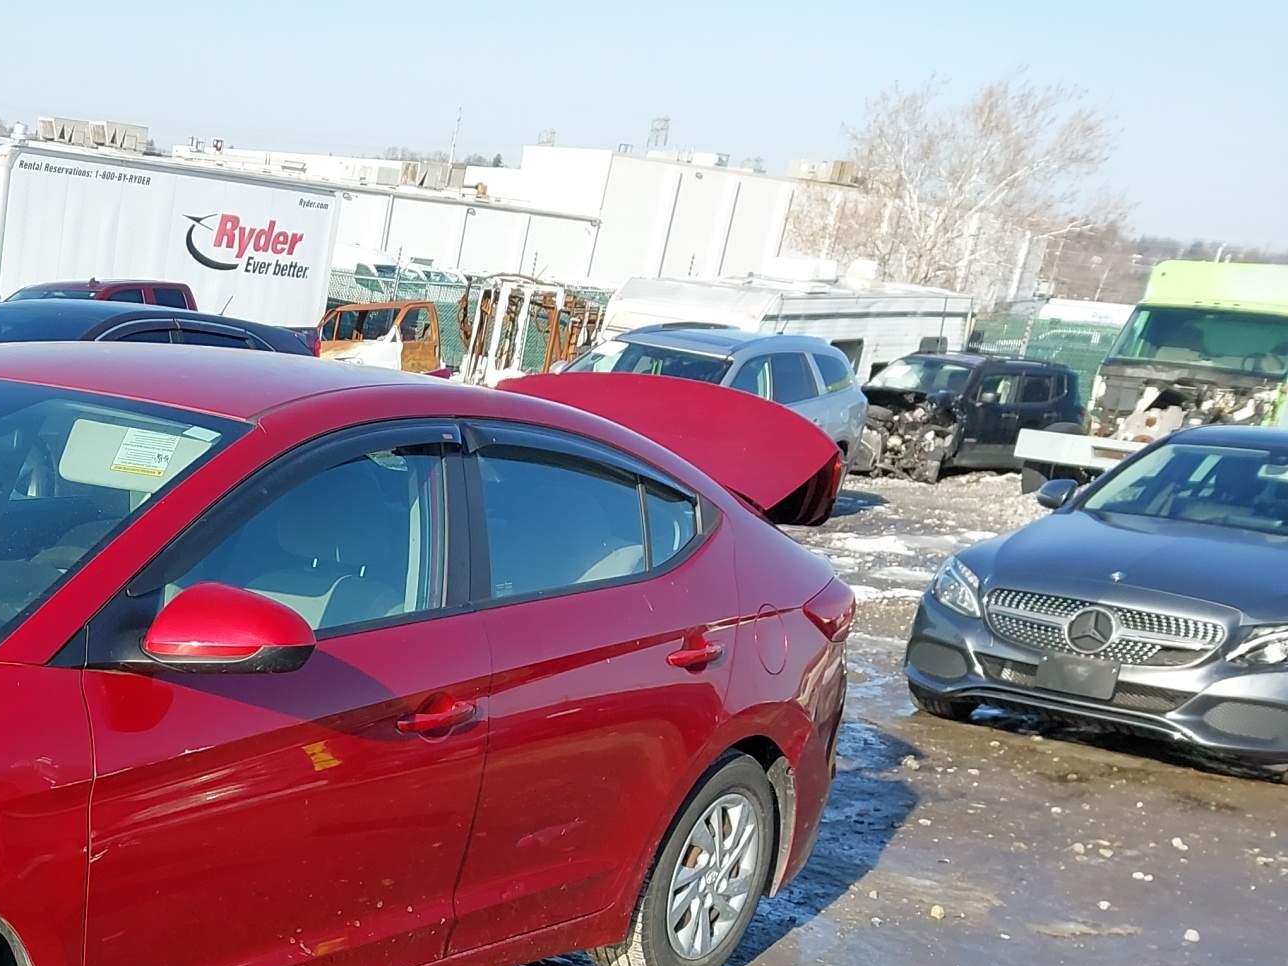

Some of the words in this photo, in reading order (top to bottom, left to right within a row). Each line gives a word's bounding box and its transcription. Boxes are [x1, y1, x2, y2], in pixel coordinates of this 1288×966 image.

[19, 159, 43, 171] Rental
[44, 162, 93, 178] Reservations:
[95, 169, 151, 186] 1-800-BY-RYDER
[298, 197, 329, 210] Ryder.com
[213, 212, 305, 259] Ryder
[244, 256, 272, 276] Ever
[272, 258, 310, 279] better.
